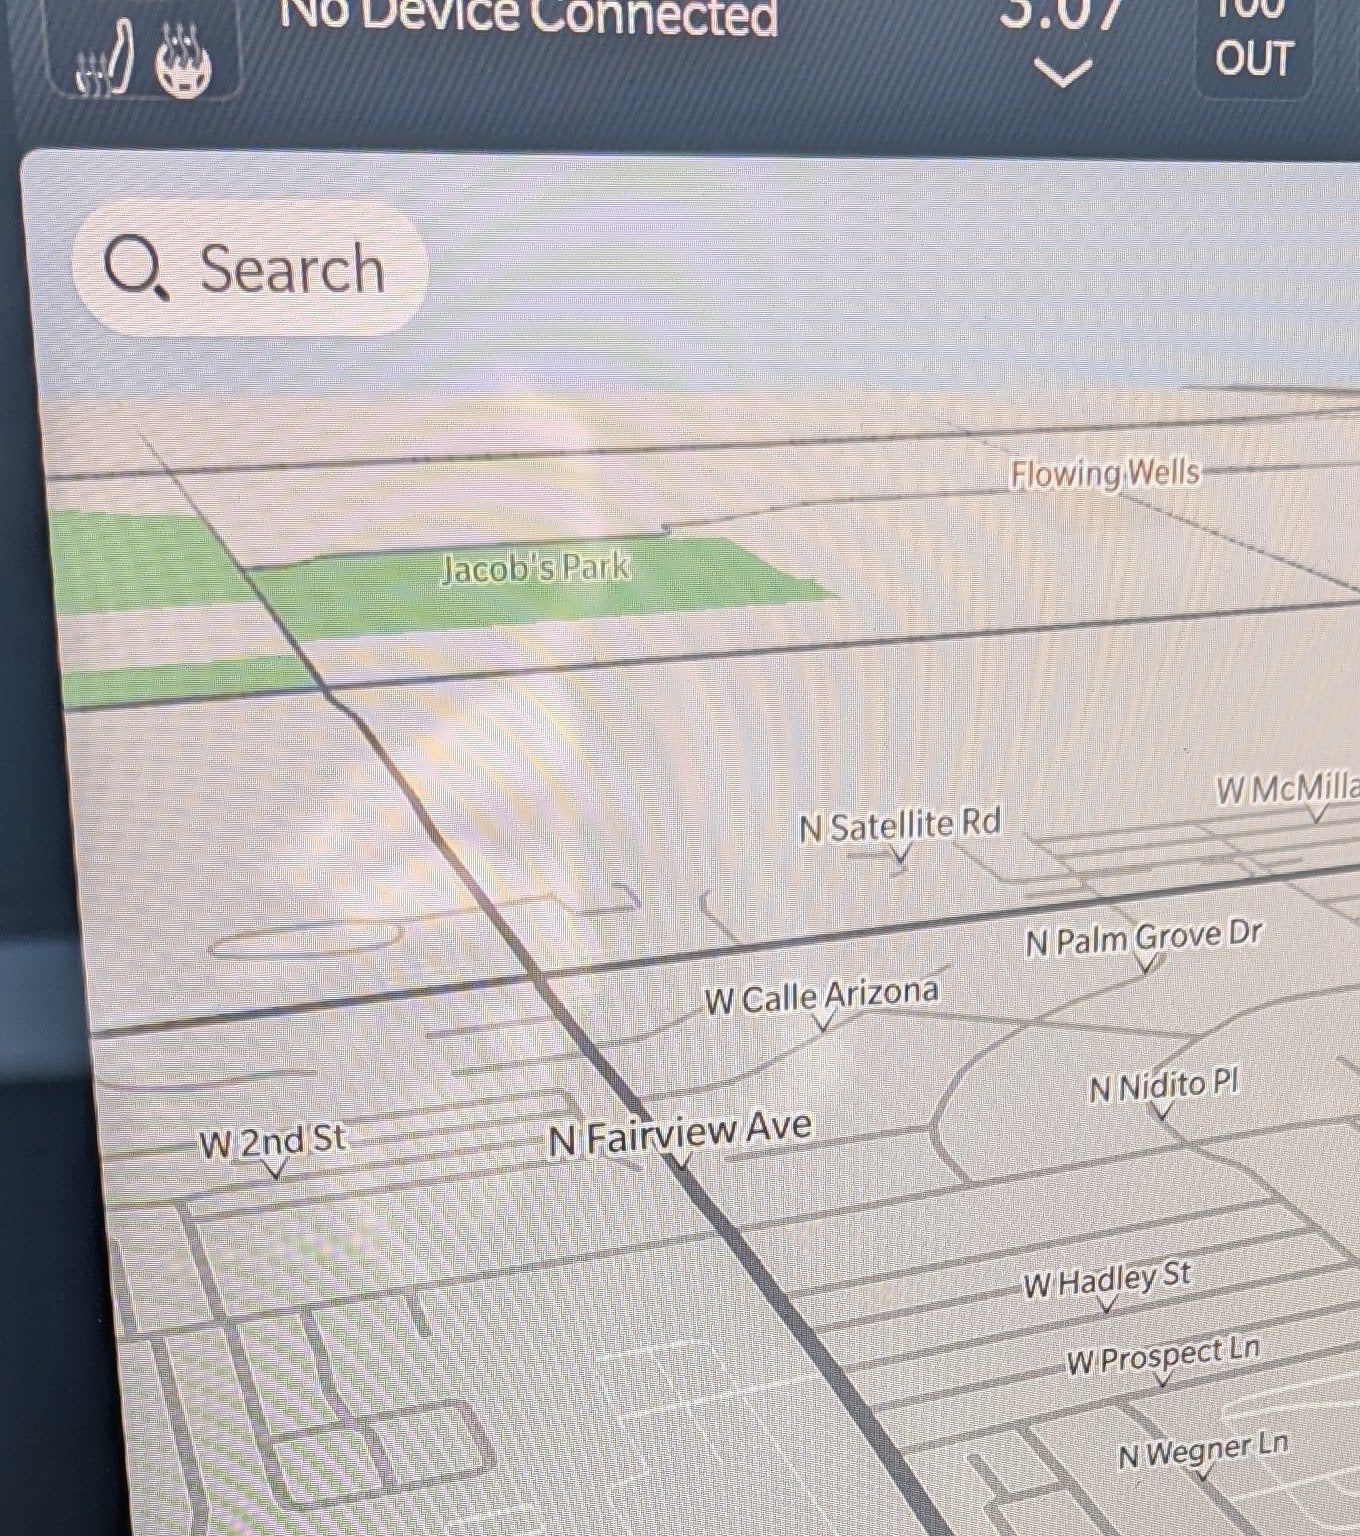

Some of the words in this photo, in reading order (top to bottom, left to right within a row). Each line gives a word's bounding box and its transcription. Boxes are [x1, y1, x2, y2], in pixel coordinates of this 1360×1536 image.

[280, 0, 348, 28] No
[362, 0, 520, 31] Device
[529, 0, 779, 38] Connected
[1215, 37, 1297, 77] OUT
[201, 241, 386, 294] Search
[1011, 459, 1124, 495] Flowing
[1128, 457, 1202, 488] Wells
[440, 551, 557, 586] Jacob's
[563, 549, 630, 582] Park
[1217, 776, 1245, 804] W
[801, 815, 822, 843] N
[831, 810, 954, 841] Satellite
[962, 806, 1001, 835] Rd
[1026, 929, 1047, 956] N
[1057, 924, 1127, 953] Palm
[1136, 921, 1222, 949] Grove
[1229, 918, 1263, 944] Dr
[704, 988, 734, 1015] W
[742, 983, 817, 1012] Calle
[824, 978, 939, 1007] Arizona
[1090, 1078, 1111, 1102] N
[1120, 1071, 1206, 1100] Nidito
[1214, 1066, 1239, 1093] Pl
[198, 1132, 231, 1160] W
[242, 1128, 304, 1158] 2nd
[313, 1124, 347, 1152] St
[550, 1126, 576, 1156] N
[588, 1115, 737, 1153] Fairview
[745, 1110, 812, 1141] Ave
[1024, 1273, 1052, 1298] W
[1059, 1265, 1157, 1295] Hadley
[1163, 1259, 1192, 1286] St
[1067, 1351, 1094, 1376] W
[1102, 1340, 1223, 1373] Prospect
[1230, 1336, 1261, 1360] Ln
[1119, 1444, 1139, 1469] N
[1146, 1436, 1252, 1468] Wegner
[1259, 1430, 1289, 1454] Ln
